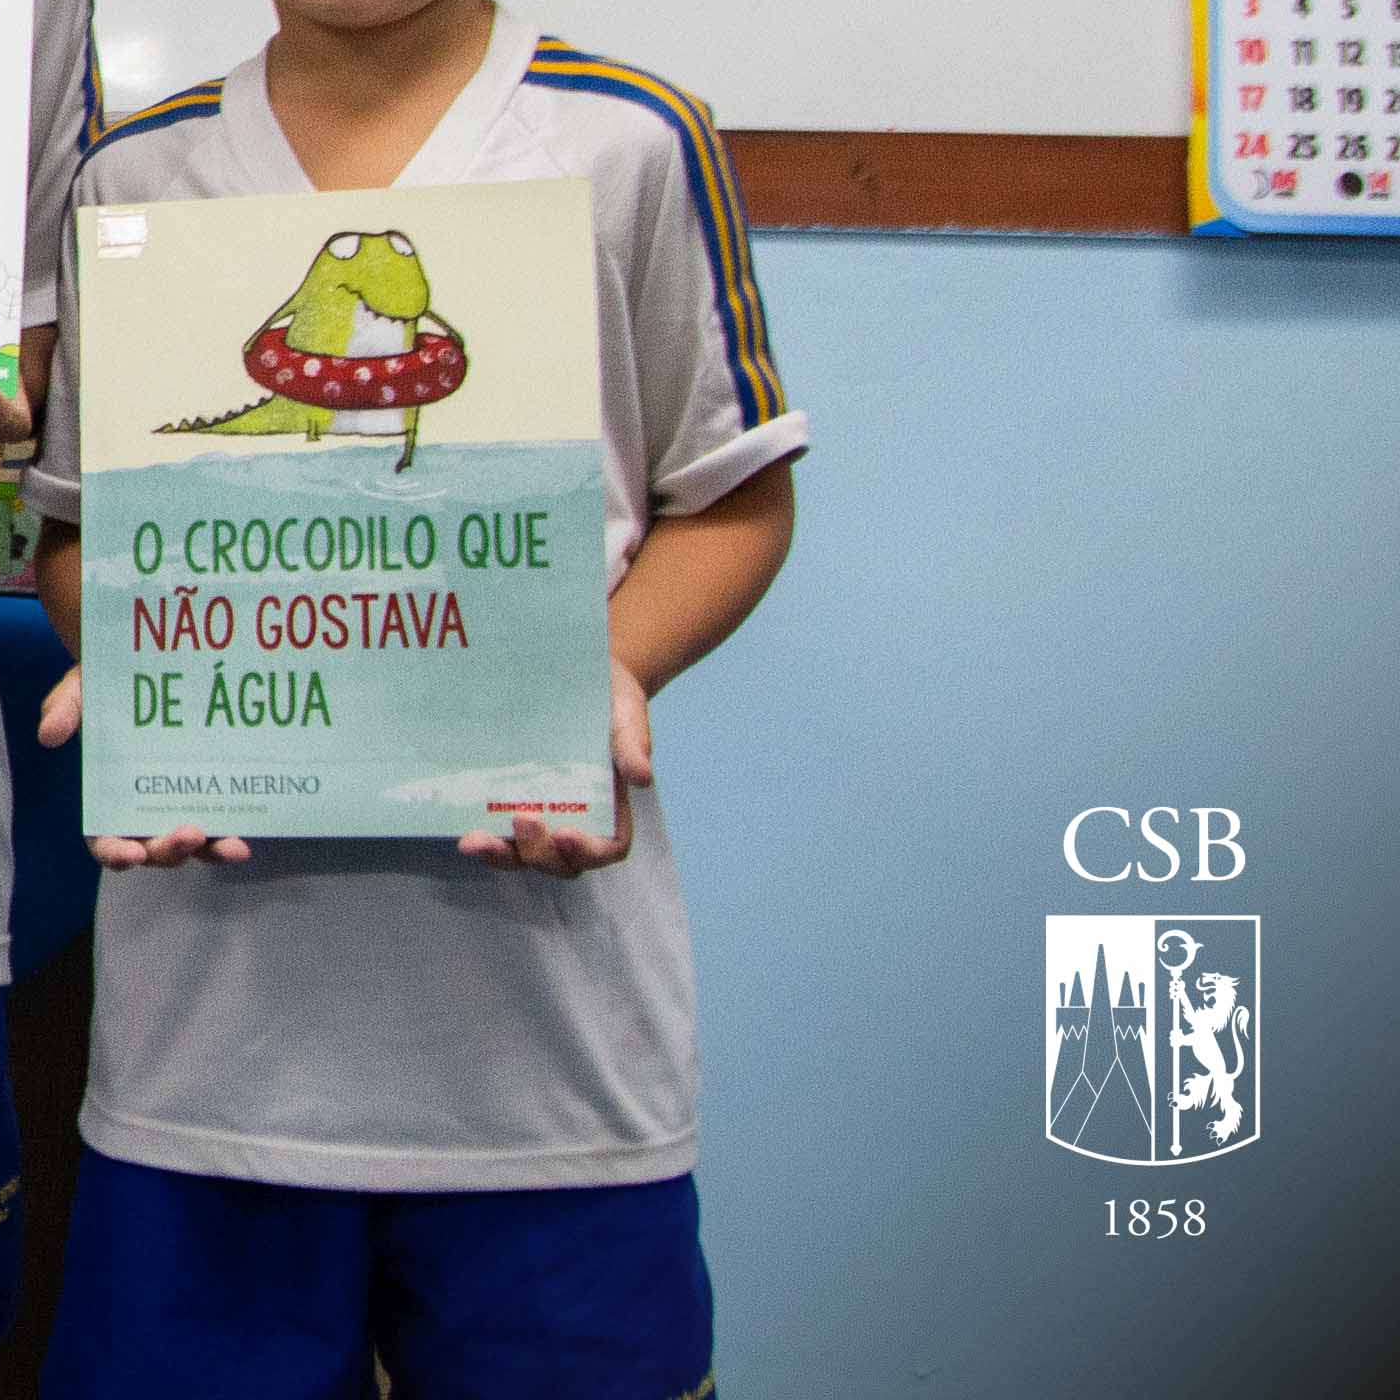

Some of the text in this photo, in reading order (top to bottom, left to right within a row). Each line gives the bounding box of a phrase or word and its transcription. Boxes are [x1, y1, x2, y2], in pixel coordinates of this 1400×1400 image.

[1290, 39, 1314, 66] 11
[1337, 40, 1365, 67] 12
[1237, 85, 1267, 112] 17
[1288, 86, 1315, 113] 18
[1336, 87, 1363, 114] 19
[1234, 131, 1269, 160] 24
[1286, 133, 1317, 160] 25
[1336, 133, 1368, 161] 26
[133, 511, 550, 575] O CROCODILO QUE
[133, 586, 469, 652] NÃO GOSTAVA
[133, 661, 332, 728] DE ÁGUA
[135, 774, 321, 794] GEMMA MERINO
